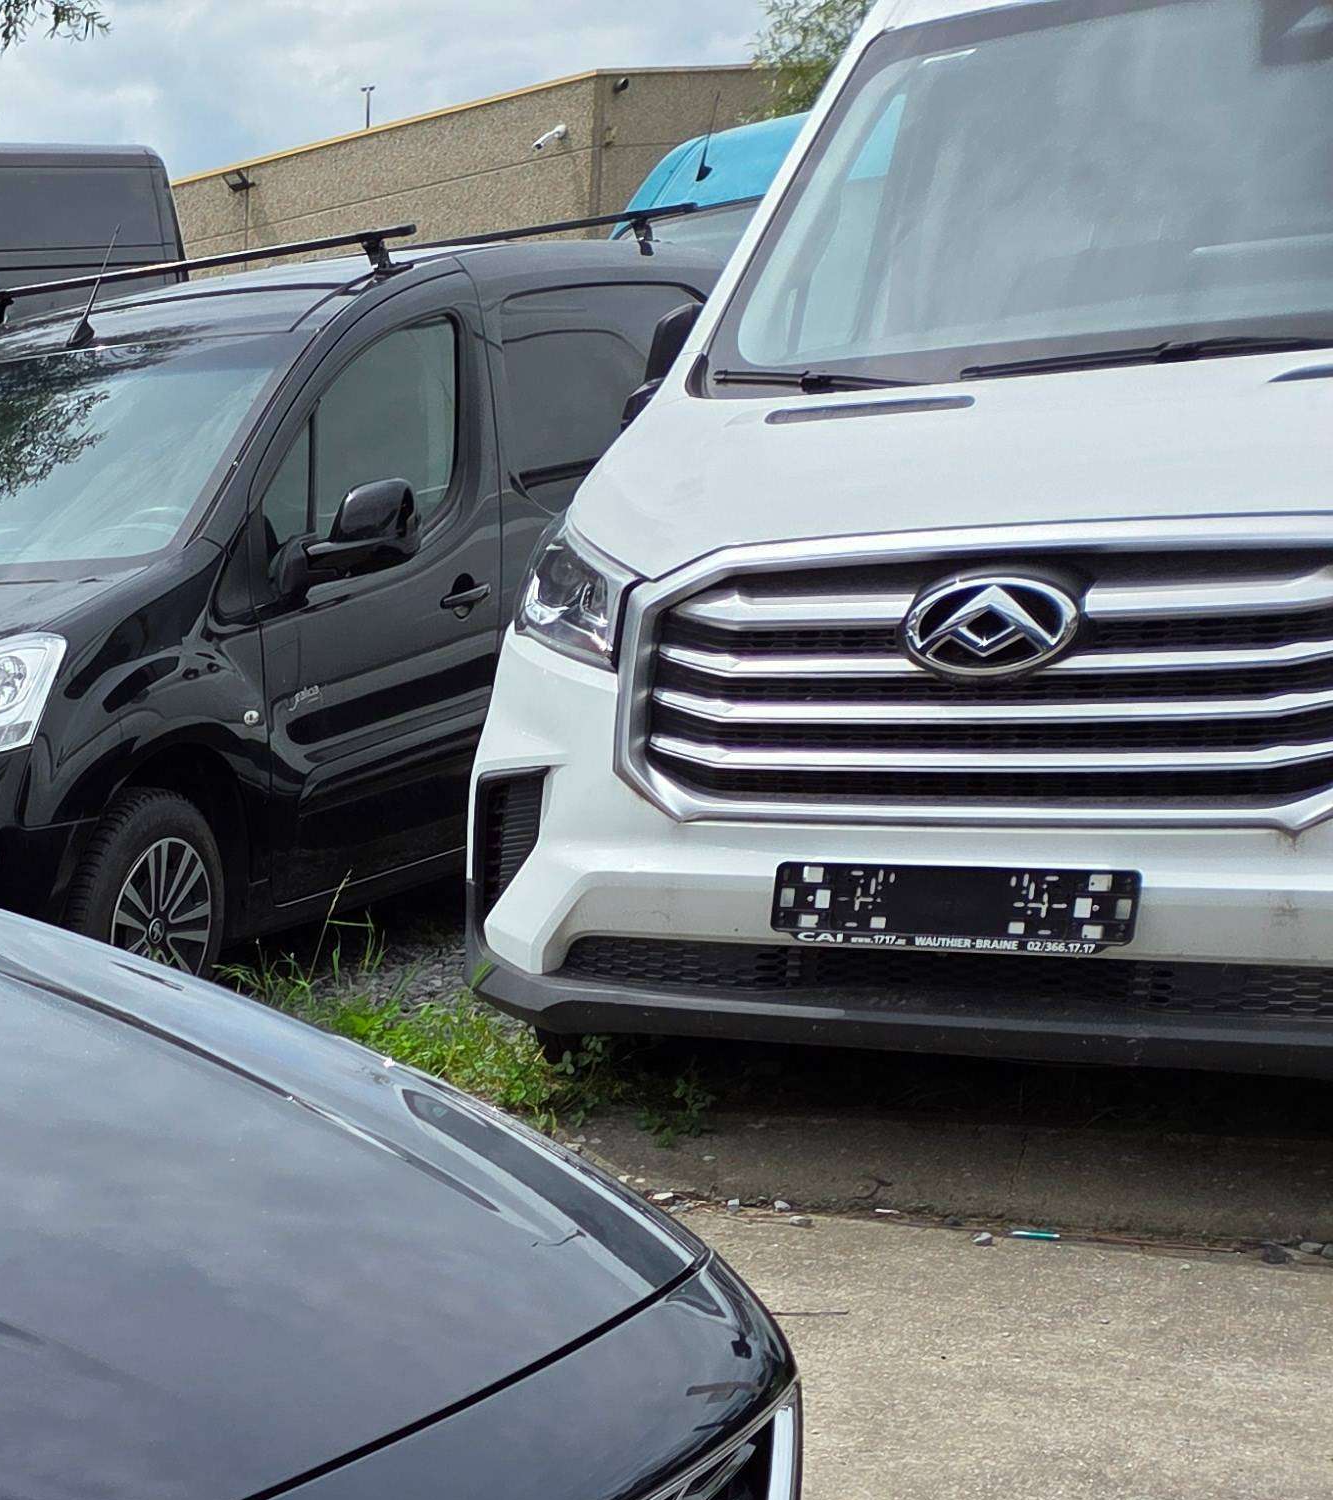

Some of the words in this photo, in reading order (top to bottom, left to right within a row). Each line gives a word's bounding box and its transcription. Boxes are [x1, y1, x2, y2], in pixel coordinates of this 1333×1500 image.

[797, 931, 844, 943] CAI
[914, 936, 1019, 951] WAUTHIER-BRAINE
[1026, 941, 1096, 954] 02/366.17.17
